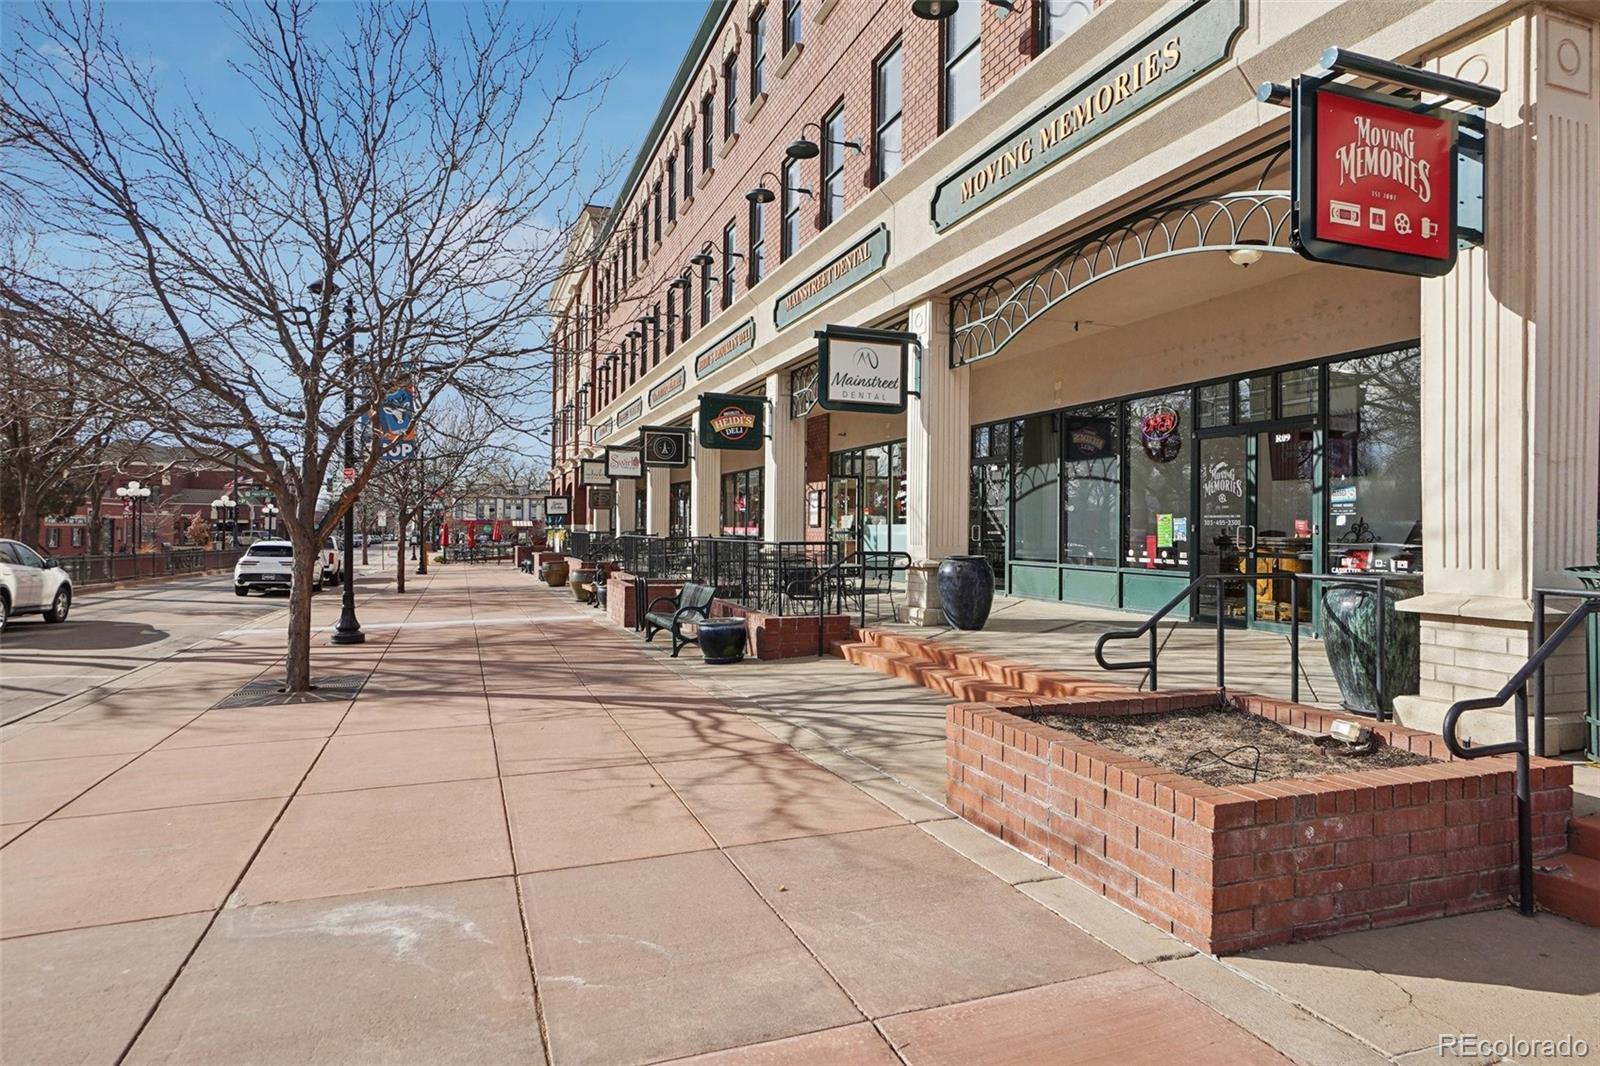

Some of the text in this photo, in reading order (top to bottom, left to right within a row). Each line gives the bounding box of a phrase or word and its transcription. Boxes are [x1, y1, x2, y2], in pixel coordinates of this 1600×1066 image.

[959, 37, 1183, 204] MOVING MEMORIES
[1354, 116, 1415, 159] MOVING
[1336, 142, 1431, 203] MEMORIES
[786, 242, 872, 312] MAINSTREET DENTAL
[831, 371, 899, 389] Mainstreet
[842, 390, 887, 401] DENTAL
[714, 415, 752, 429] HEIDI'S
[725, 427, 743, 435] DELI
[1203, 479, 1242, 498] MEMORIES
